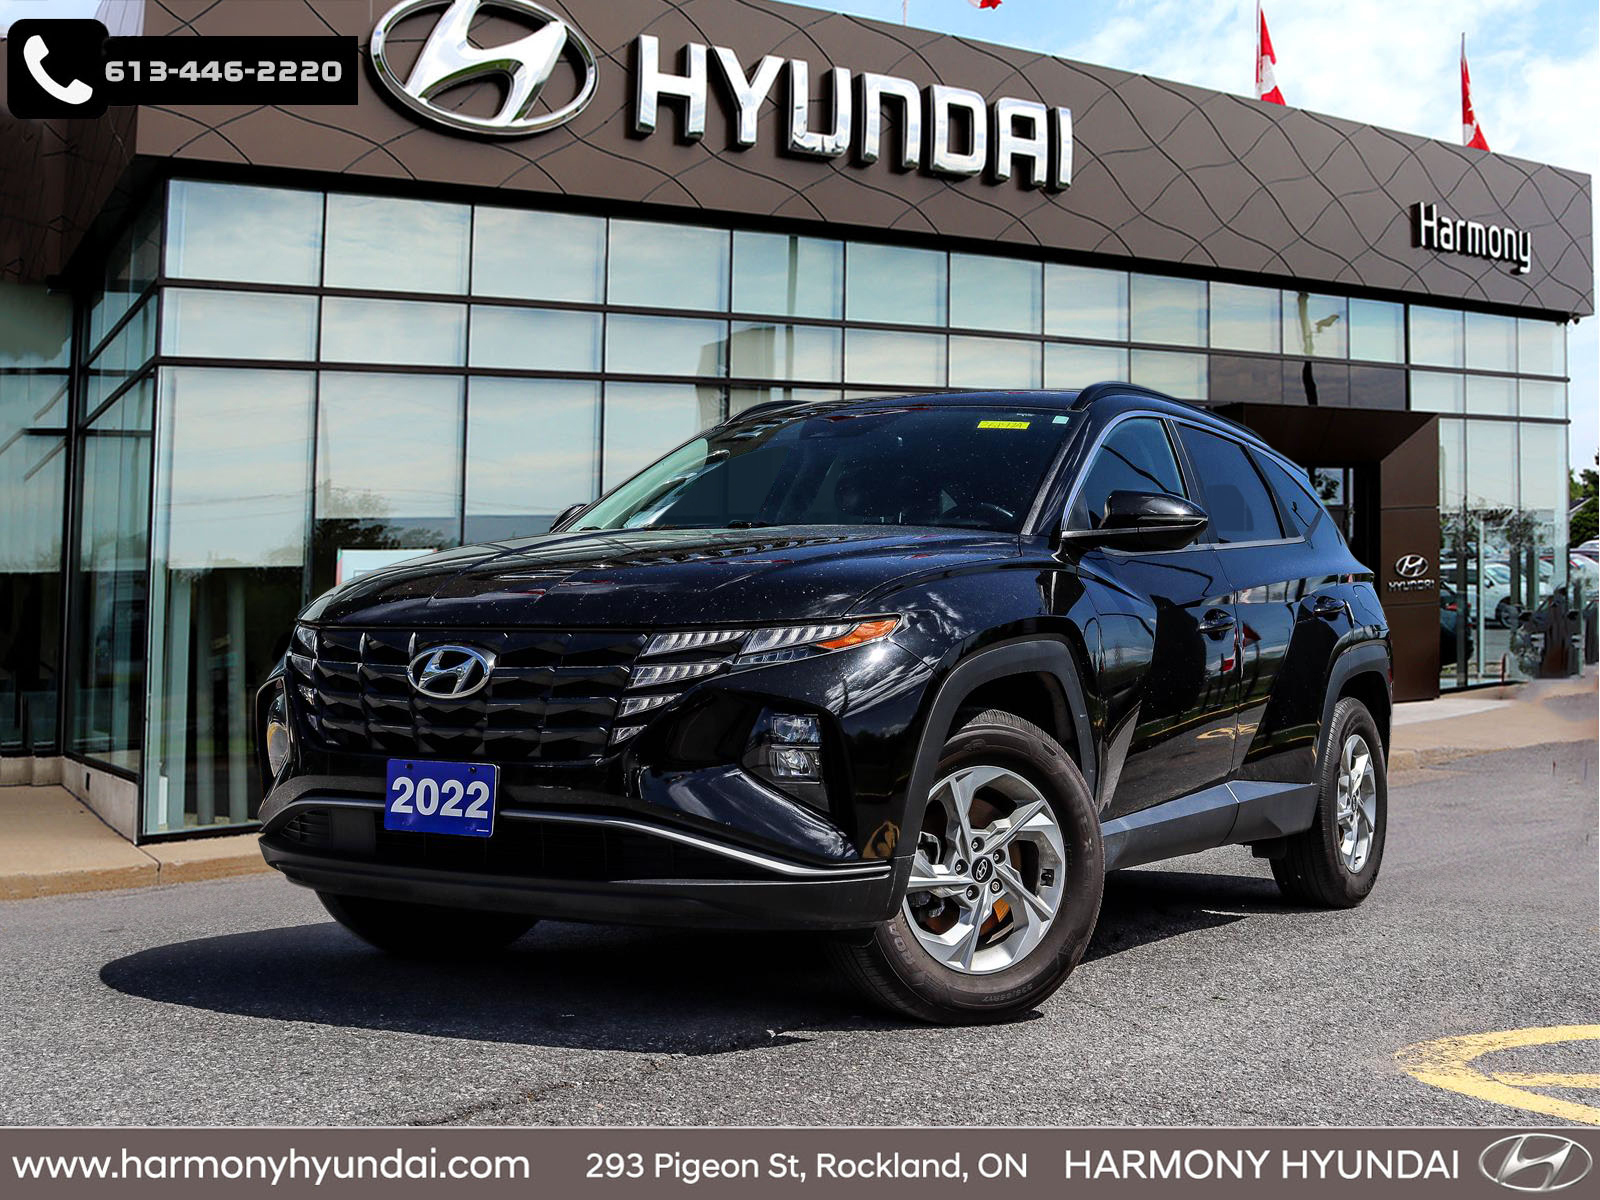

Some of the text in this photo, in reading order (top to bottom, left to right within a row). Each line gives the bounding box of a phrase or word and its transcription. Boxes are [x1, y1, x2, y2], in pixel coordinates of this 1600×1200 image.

[635, 34, 1073, 190] HYUNDAI
[1417, 201, 1532, 275] Harmony
[1388, 579, 1436, 591] HYUNDAI
[390, 776, 490, 819] 2022
